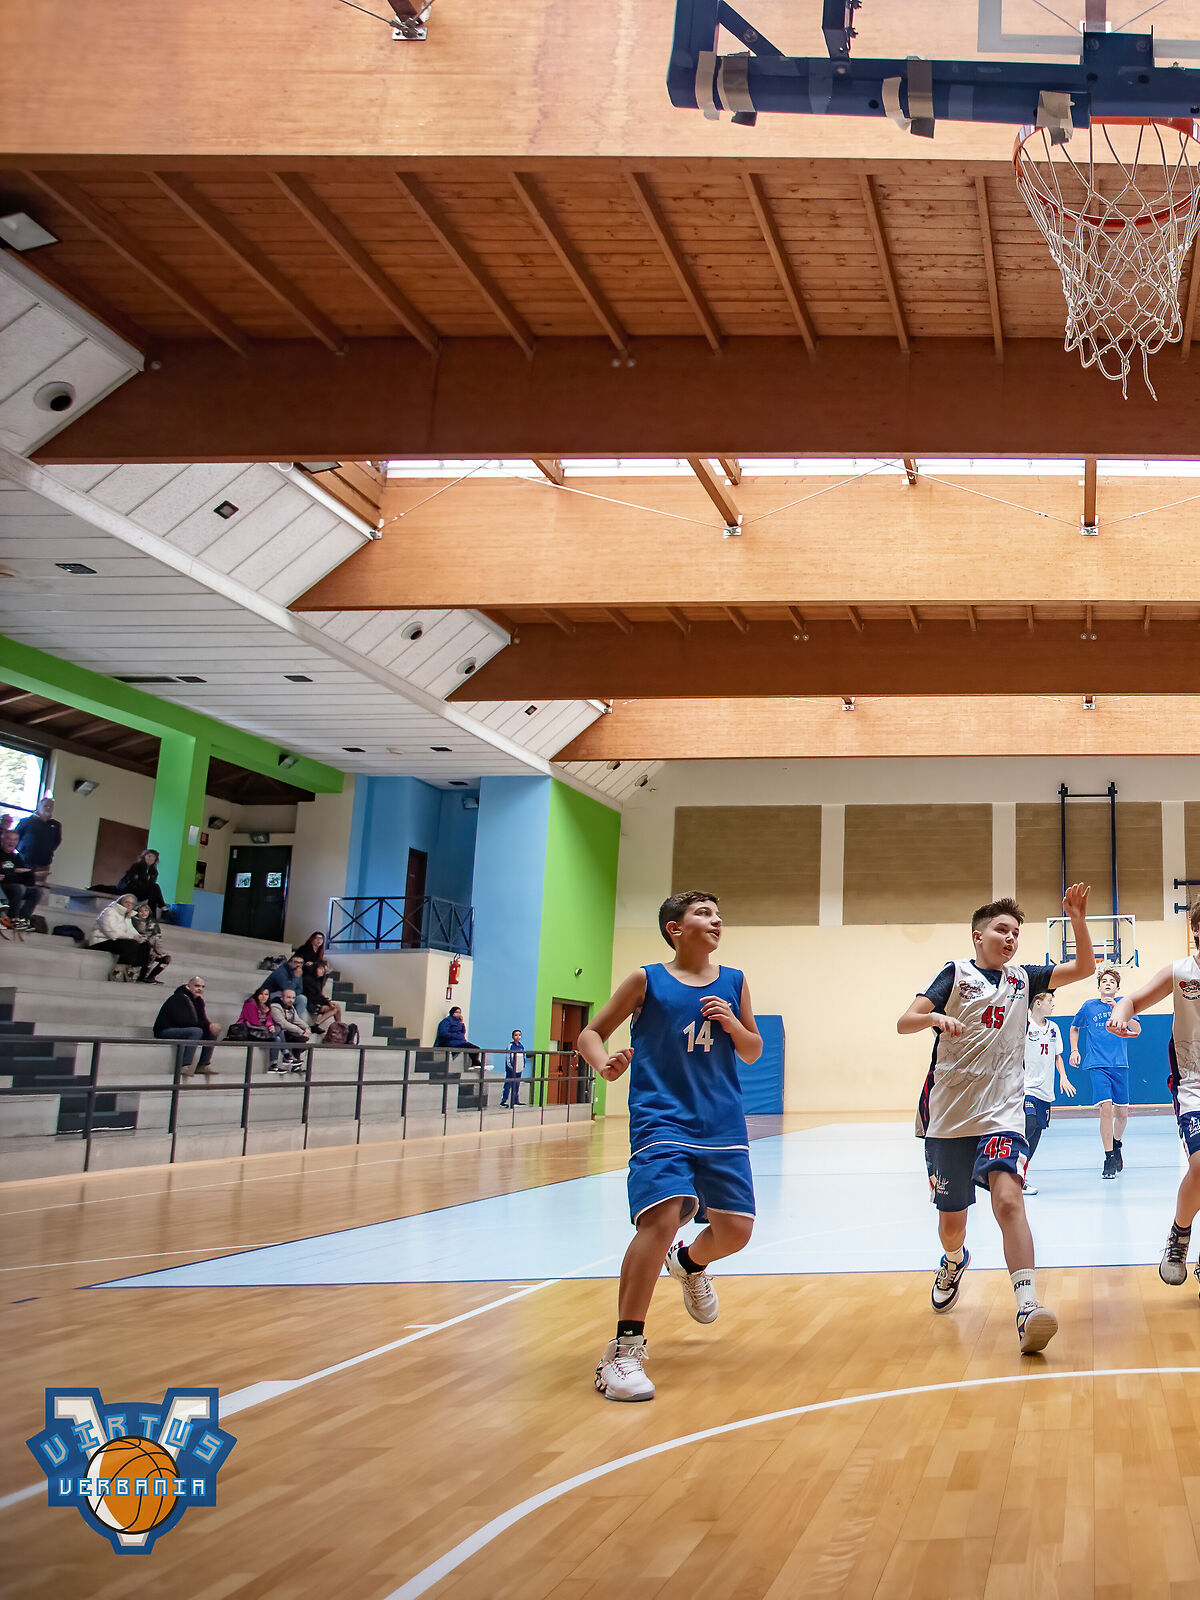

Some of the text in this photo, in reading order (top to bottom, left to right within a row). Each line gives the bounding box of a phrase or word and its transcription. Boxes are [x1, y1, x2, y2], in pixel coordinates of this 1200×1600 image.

[981, 1005, 1005, 1029] 45
[682, 1020, 714, 1053] 14
[1040, 1043, 1049, 1056] 75
[983, 1136, 1014, 1160] 45
